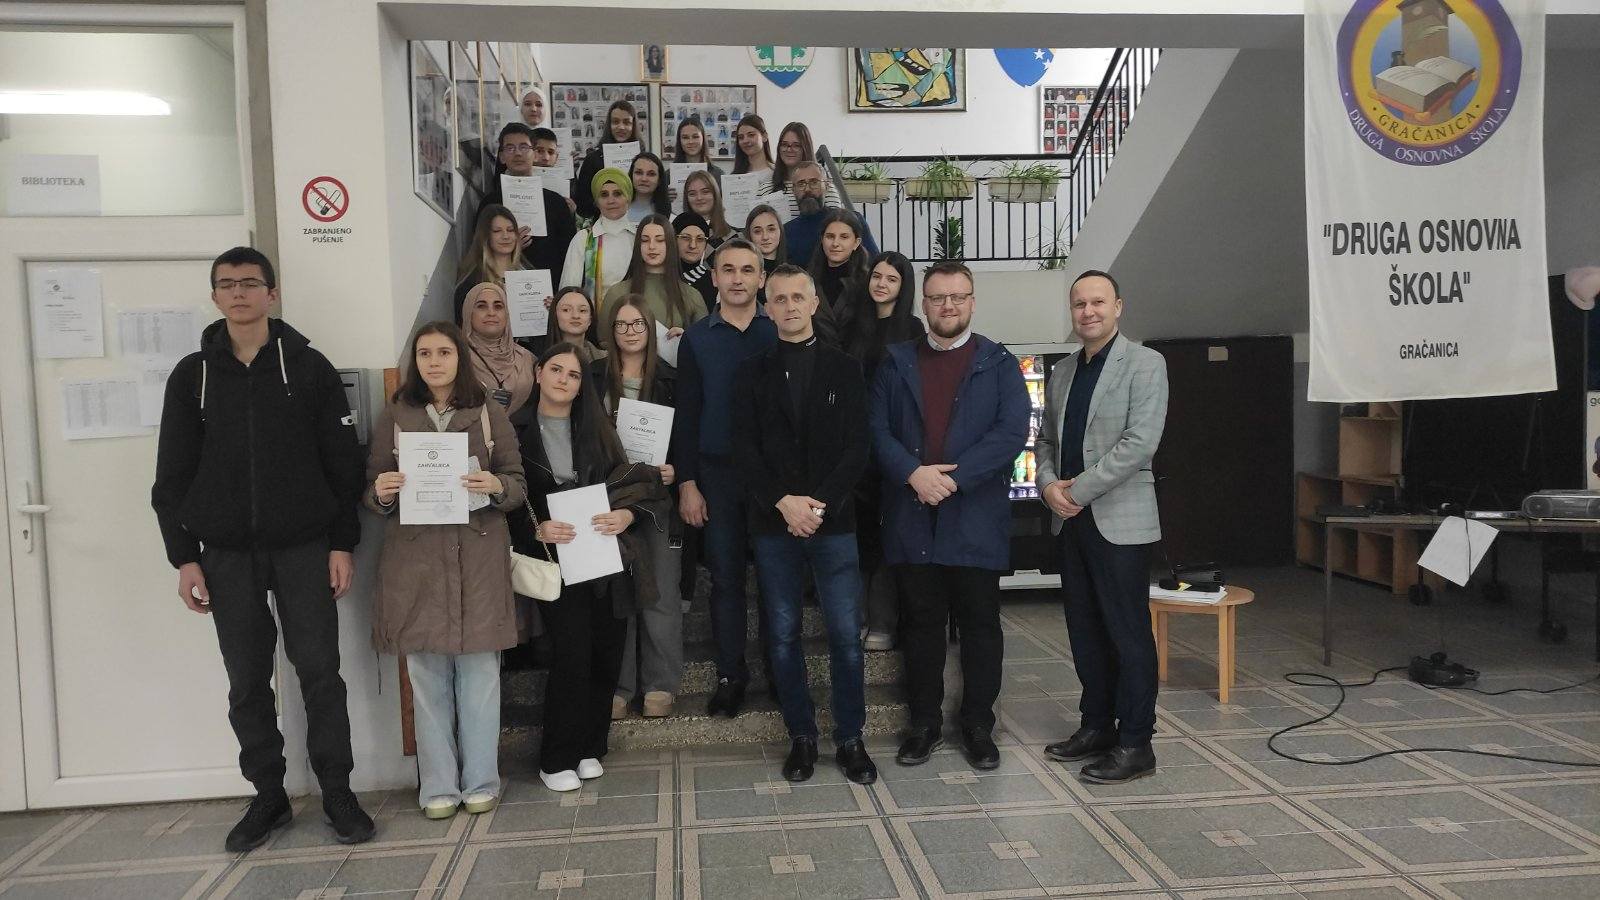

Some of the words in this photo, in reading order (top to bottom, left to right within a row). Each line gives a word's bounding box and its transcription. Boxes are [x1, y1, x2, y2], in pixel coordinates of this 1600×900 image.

[1349, 109, 1384, 150] DRUGA
[1395, 144, 1463, 163] OSNOVNA
[1470, 107, 1508, 145] ŠKOLA
[1378, 112, 1477, 141] GRAČANICA
[21, 176, 86, 186] BIBLIOTEKA
[312, 235, 344, 243] PUŠENJE
[1323, 221, 1412, 256] "DRUGA
[1418, 218, 1522, 253] OSNOVNA
[1388, 263, 1471, 307] ŠKOLA"
[1399, 339, 1460, 360] GRAČANICA
